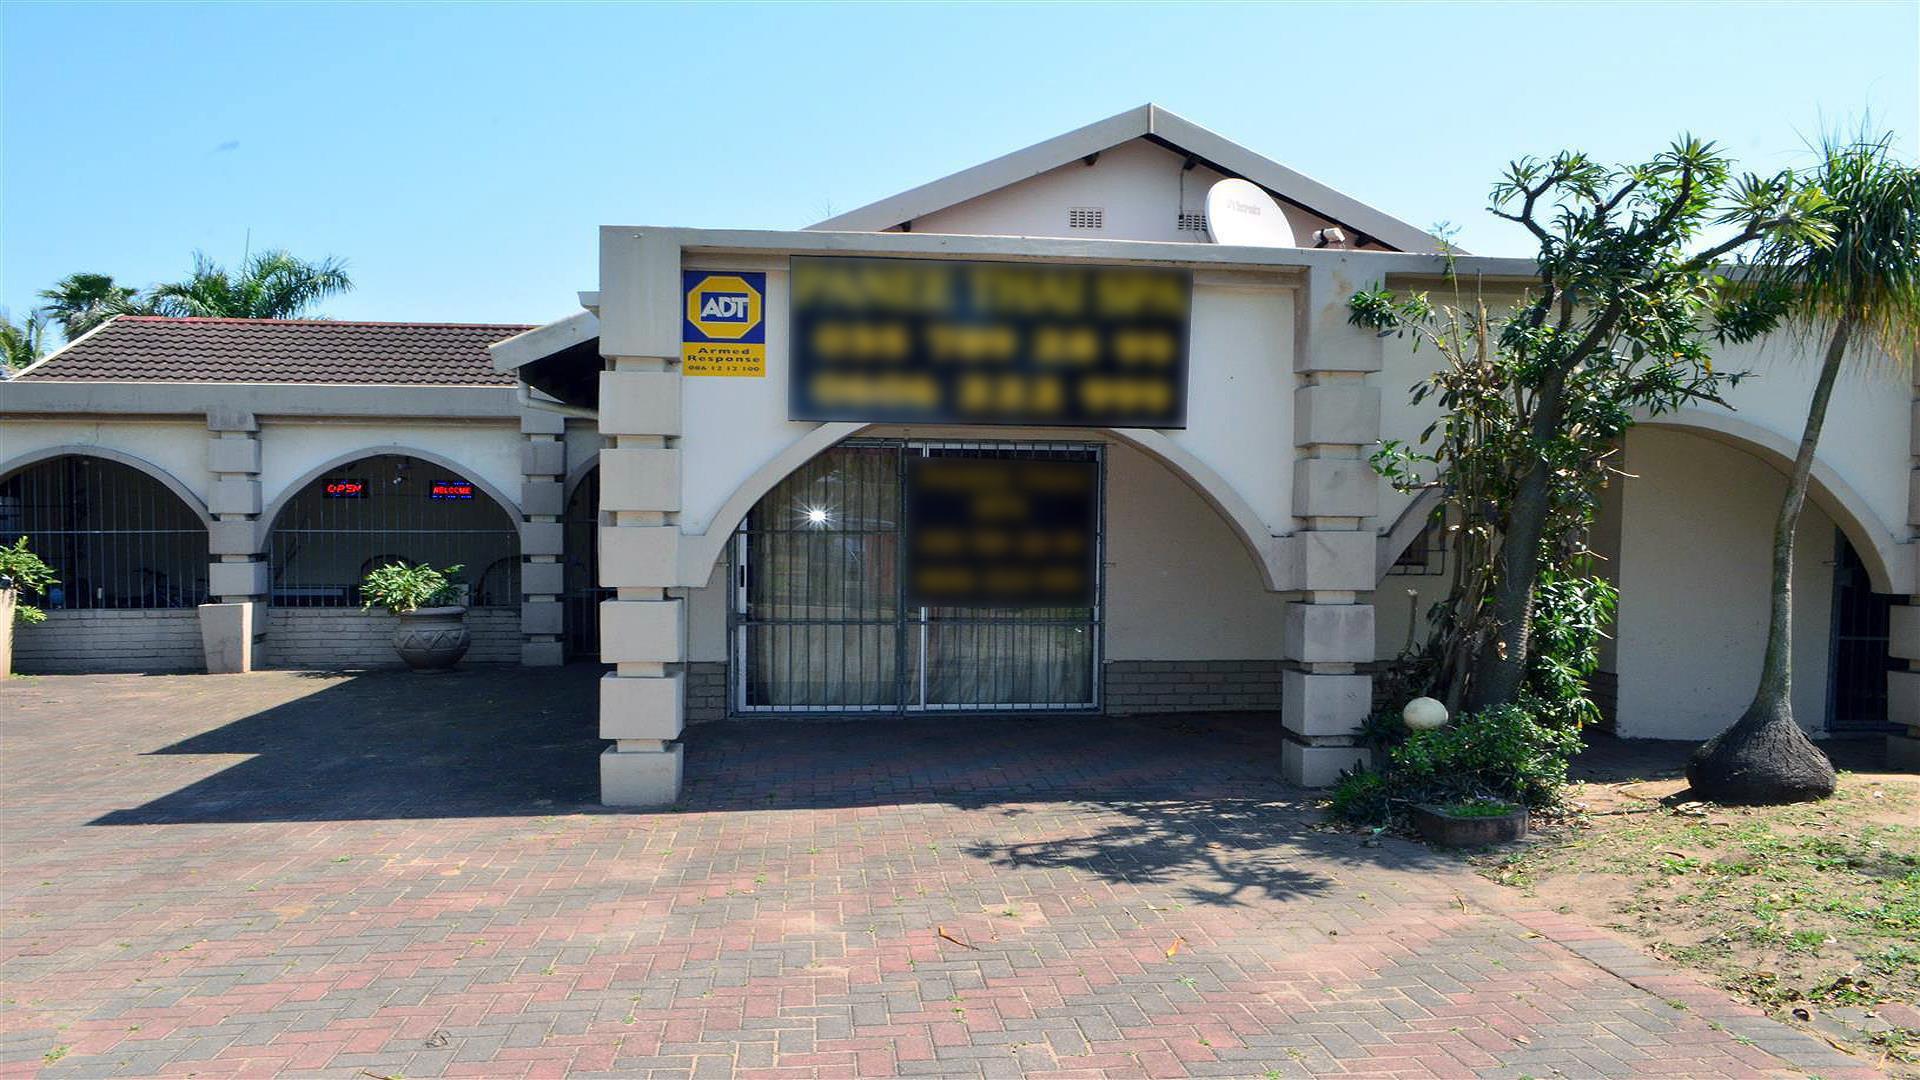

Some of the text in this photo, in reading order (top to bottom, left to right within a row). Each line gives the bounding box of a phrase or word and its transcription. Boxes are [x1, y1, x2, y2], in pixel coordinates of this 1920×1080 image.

[701, 296, 750, 318] ADT
[687, 354, 760, 363] Response
[327, 483, 362, 493] OPEN
